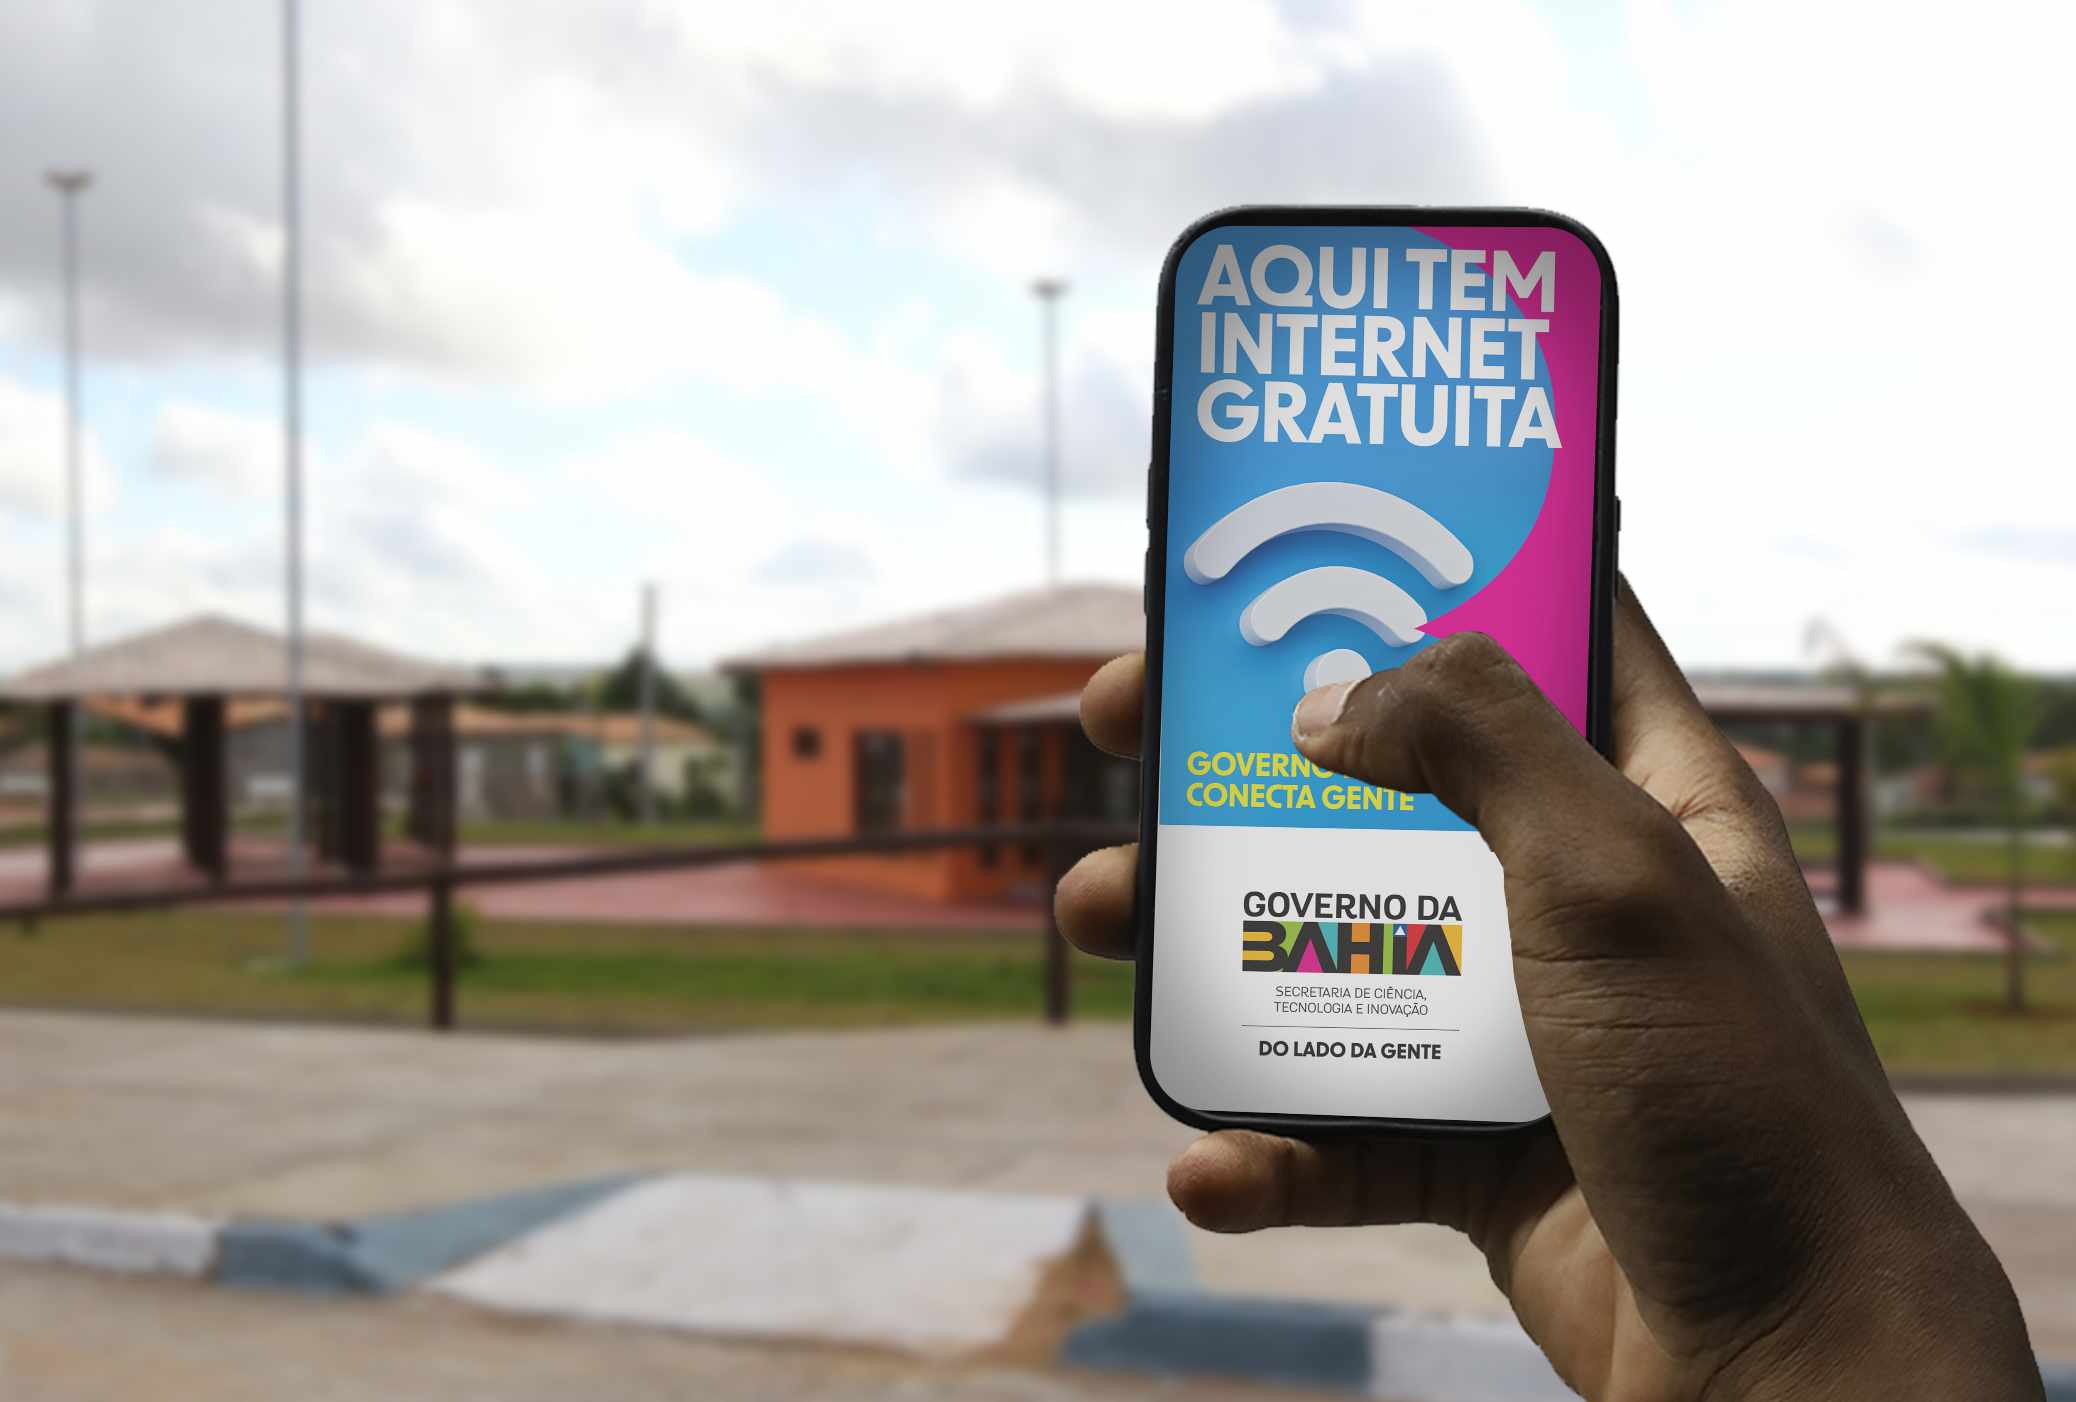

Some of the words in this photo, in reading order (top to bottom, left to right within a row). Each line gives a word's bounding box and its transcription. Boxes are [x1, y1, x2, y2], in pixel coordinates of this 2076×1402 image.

[1197, 244, 1388, 309] AQUI
[1406, 248, 1556, 312] TEM
[1200, 312, 1550, 380] INTERNET
[1197, 379, 1562, 448] GRATUITA
[1186, 782, 1316, 809] CONECTA
[1322, 785, 1415, 811] GENTE
[1243, 891, 1407, 921] GOVERNO
[1417, 895, 1463, 922] DA
[1242, 920, 1463, 977] BAHIA
[1275, 985, 1351, 999] SECRETARIA
[1354, 987, 1372, 999] DE
[1374, 986, 1427, 1001] CIÊNCIA,
[1274, 1001, 1352, 1014] TECNOLOGIA
[1356, 1003, 1363, 1014] E
[1367, 1003, 1428, 1017] INOVAÇÃO
[1259, 1040, 1289, 1057] DO
[1293, 1041, 1346, 1058] LADO
[1350, 1042, 1377, 1058] DA
[1381, 1043, 1441, 1060] GENTE
